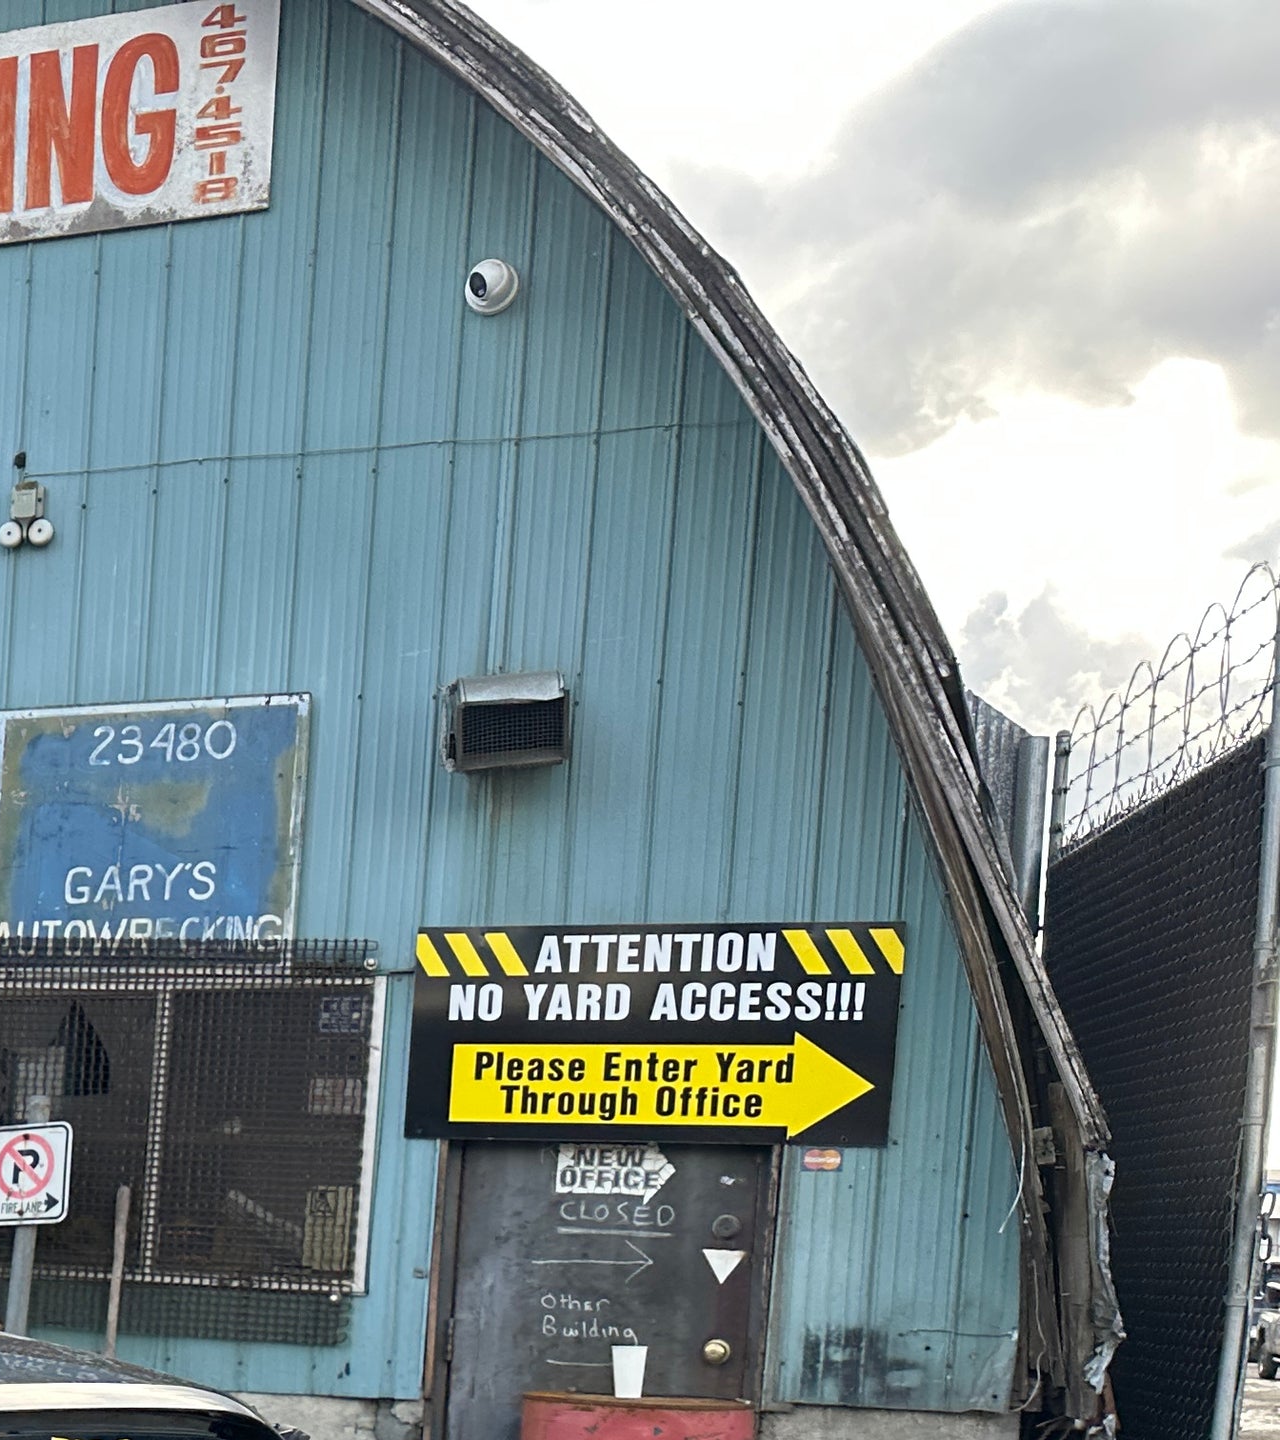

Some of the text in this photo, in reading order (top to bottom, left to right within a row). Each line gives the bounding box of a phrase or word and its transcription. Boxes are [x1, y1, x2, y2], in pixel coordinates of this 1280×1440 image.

[88, 719, 238, 767] 23480
[64, 860, 217, 905] GARY'S
[534, 932, 777, 973] ATTENTION
[448, 981, 866, 1022] NO YARD ACCESS!!!
[473, 1051, 796, 1084] Please Enter Yard
[499, 1085, 764, 1122] Through Office
[573, 1147, 643, 1167] NEW
[559, 1168, 661, 1189] OFFICE
[559, 1200, 676, 1227] CLOSED
[541, 1314, 640, 1346] Building
